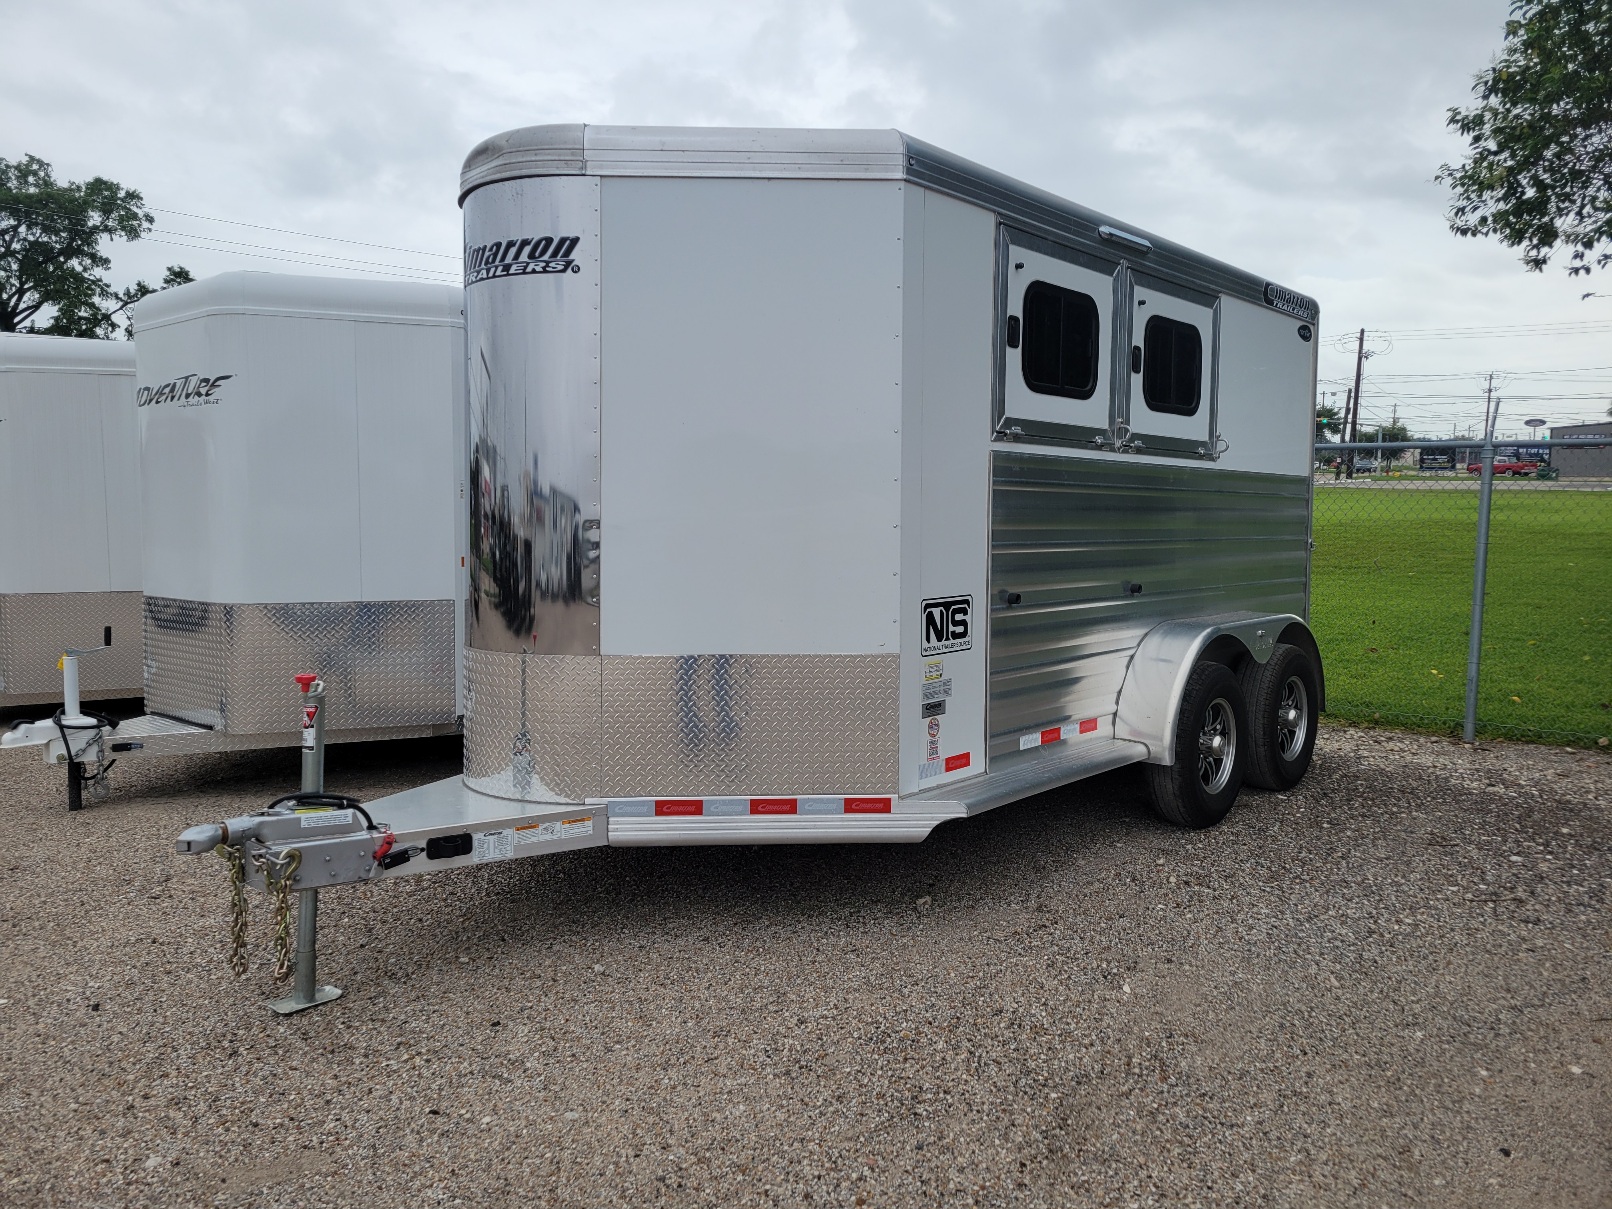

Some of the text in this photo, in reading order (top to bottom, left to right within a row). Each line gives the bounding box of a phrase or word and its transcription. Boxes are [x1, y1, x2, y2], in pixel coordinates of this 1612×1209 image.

[465, 236, 581, 273] imarron
[1273, 301, 1309, 318] TRAILERS
[923, 599, 970, 644] NTS
